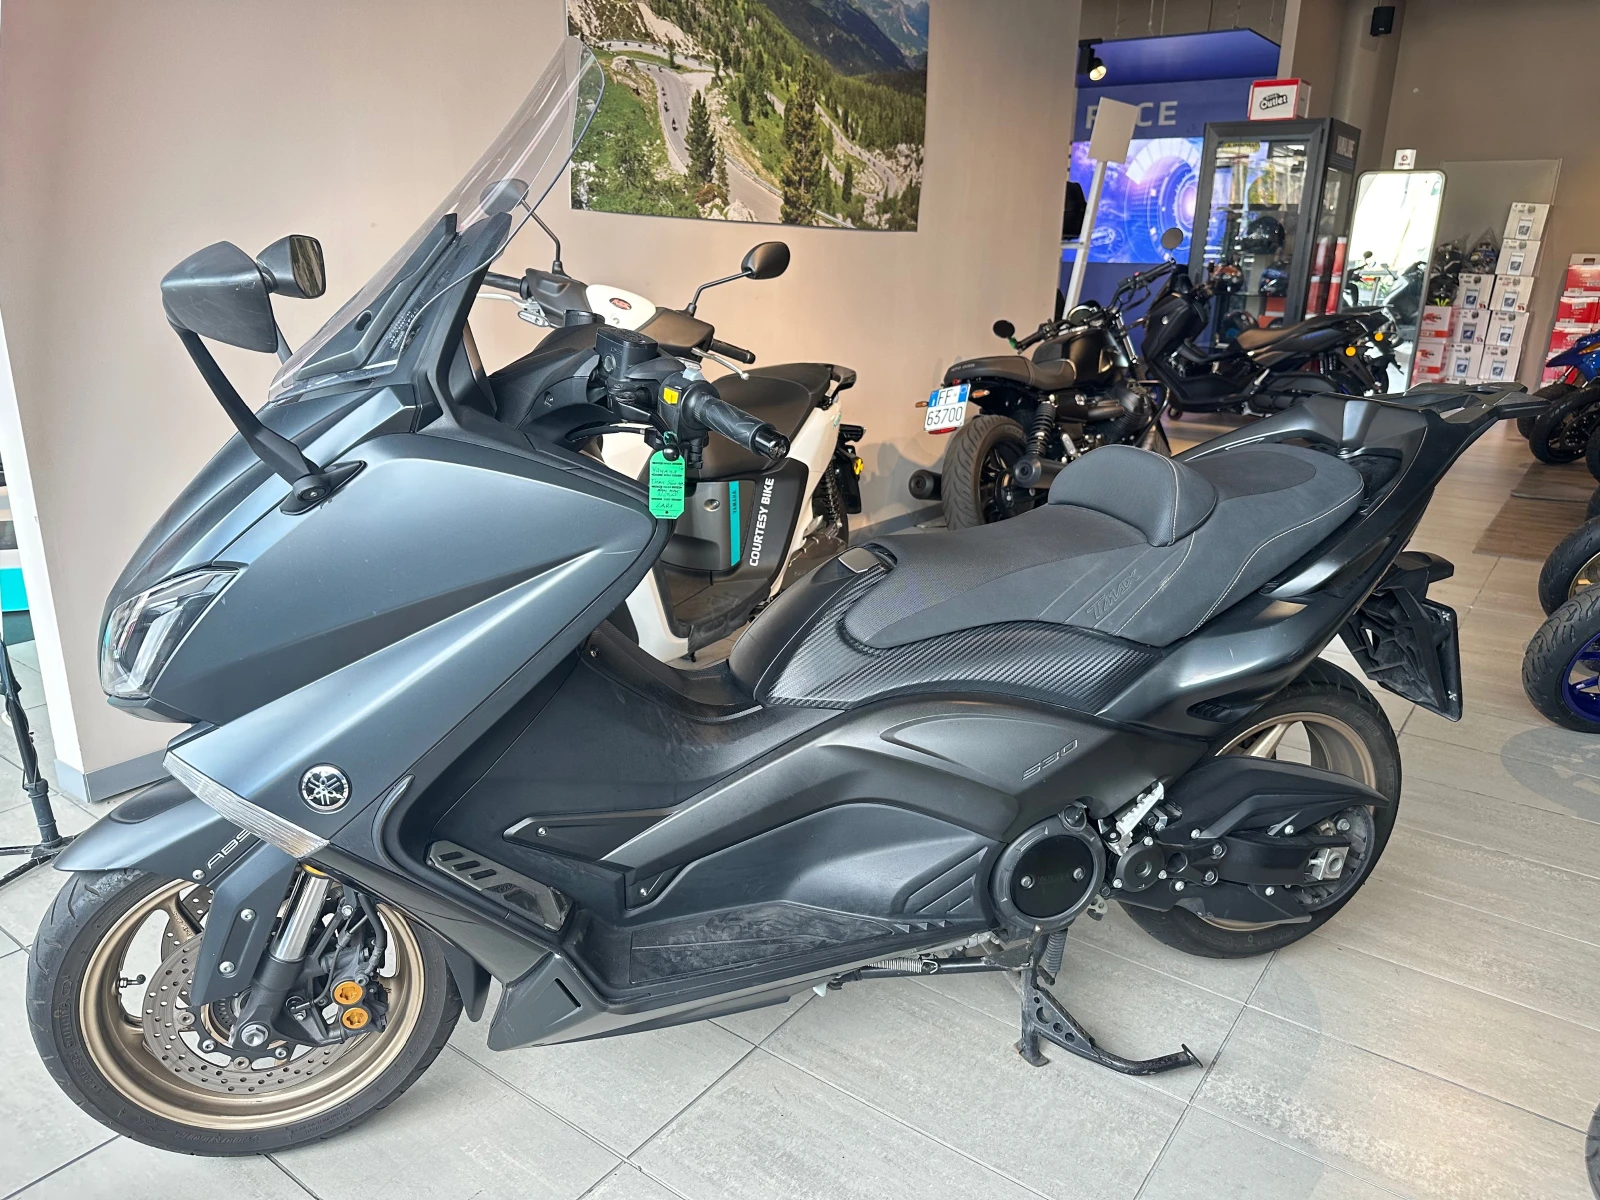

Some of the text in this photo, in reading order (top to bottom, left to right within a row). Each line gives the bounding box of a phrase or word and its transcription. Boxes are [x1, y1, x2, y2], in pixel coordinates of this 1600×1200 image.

[1260, 95, 1288, 110] Outlet
[926, 406, 963, 426] 63700
[749, 477, 775, 567] COURTESY BIKE
[1022, 739, 1078, 781] 530
[207, 828, 251, 870] ABS
